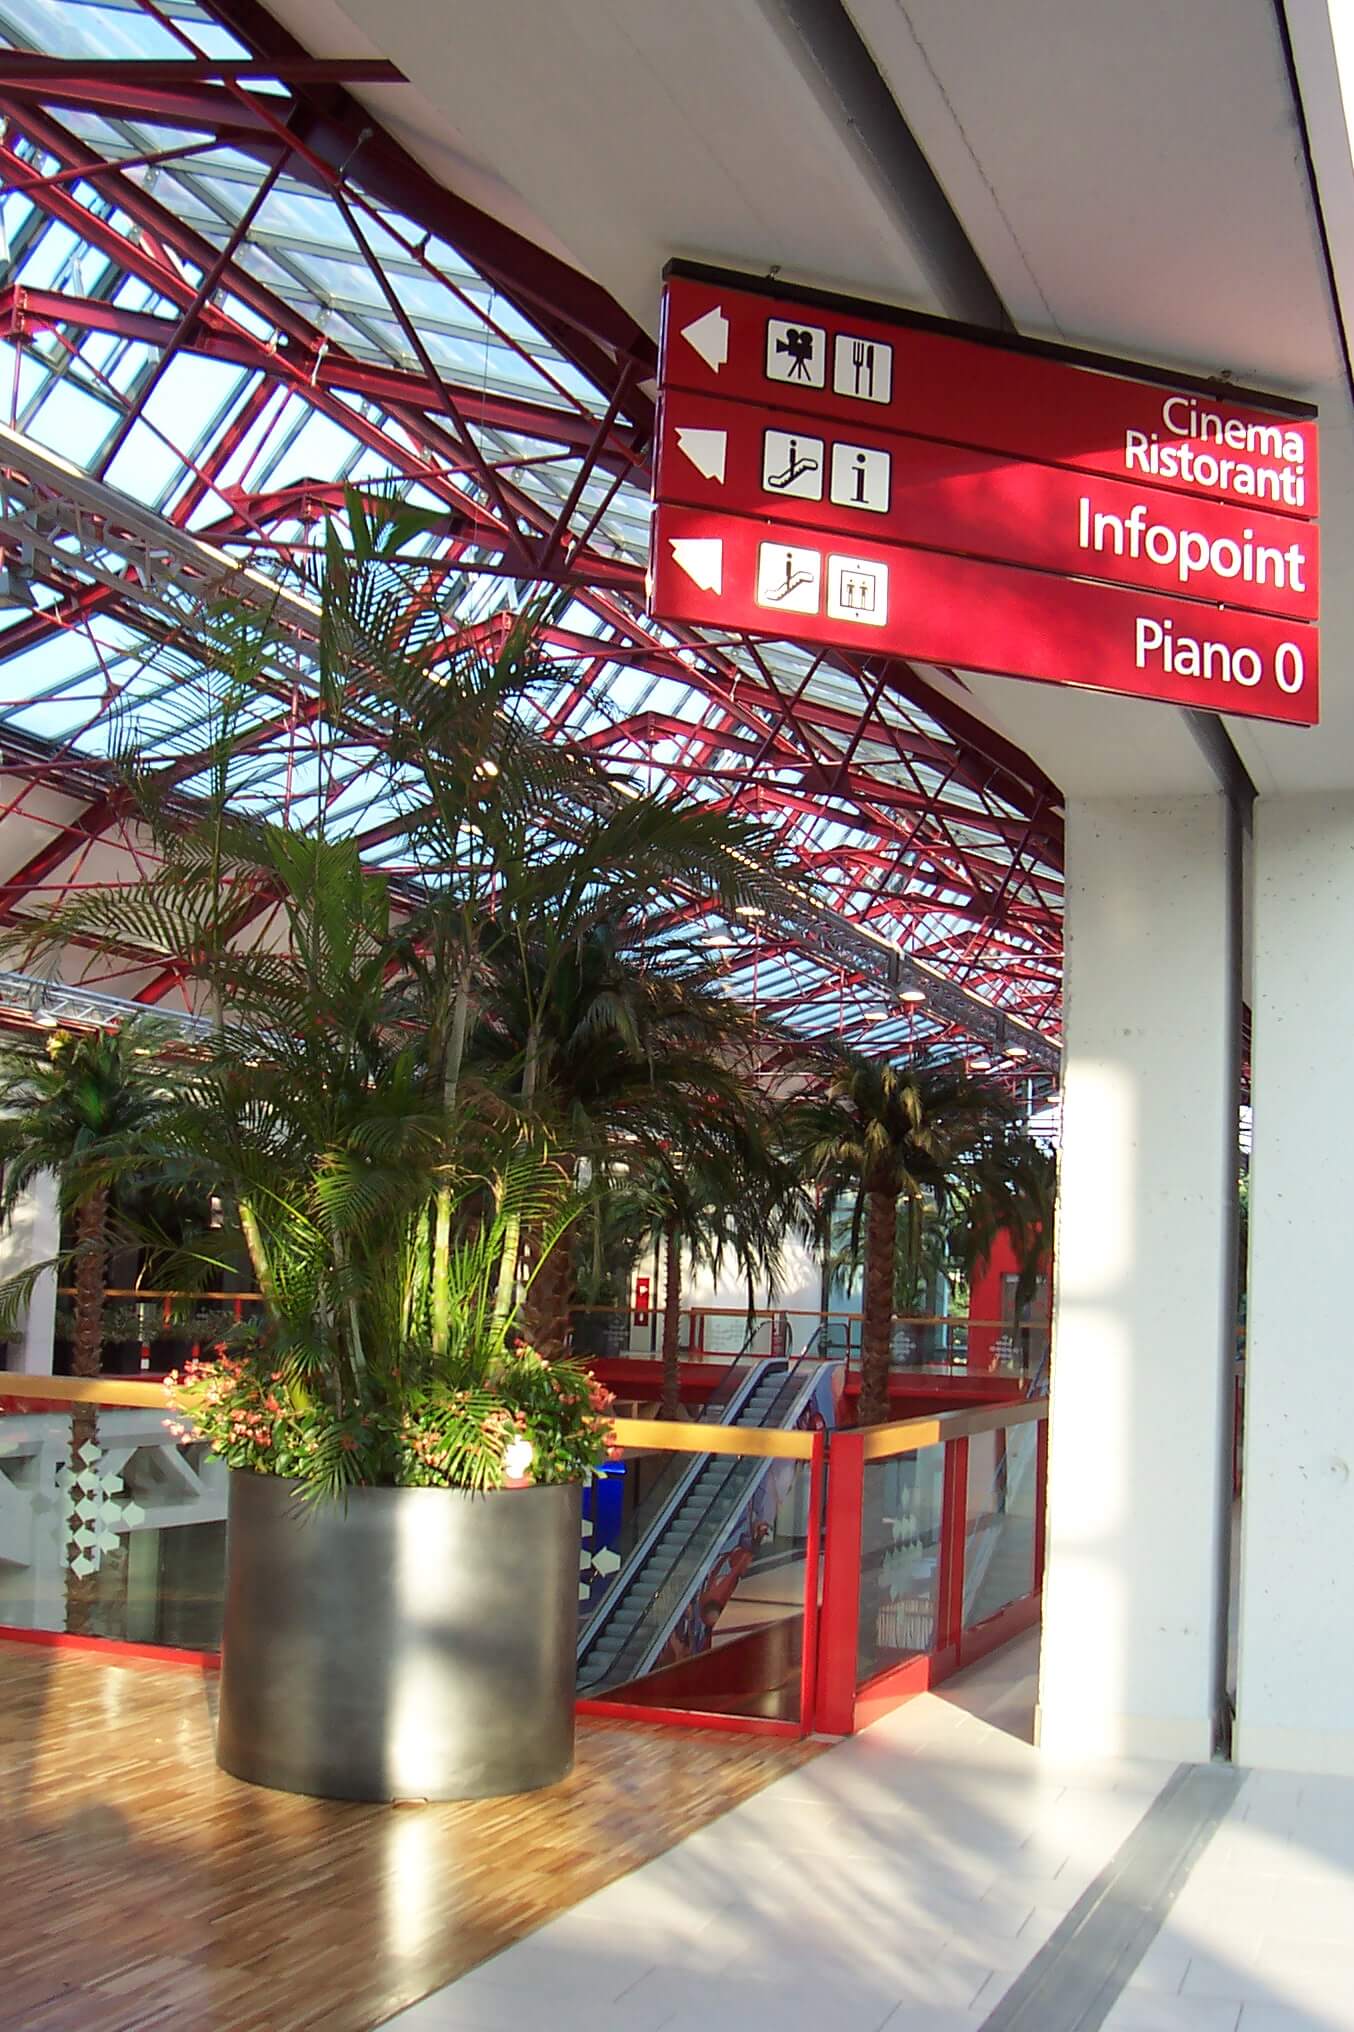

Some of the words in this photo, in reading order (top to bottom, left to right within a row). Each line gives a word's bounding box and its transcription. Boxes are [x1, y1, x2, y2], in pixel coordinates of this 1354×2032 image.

[1125, 430, 1305, 507] Ristoranti
[1162, 397, 1305, 464] Cinema
[1079, 497, 1306, 592] Infopoint
[1135, 617, 1262, 687] Piano
[1274, 642, 1304, 694] 0
